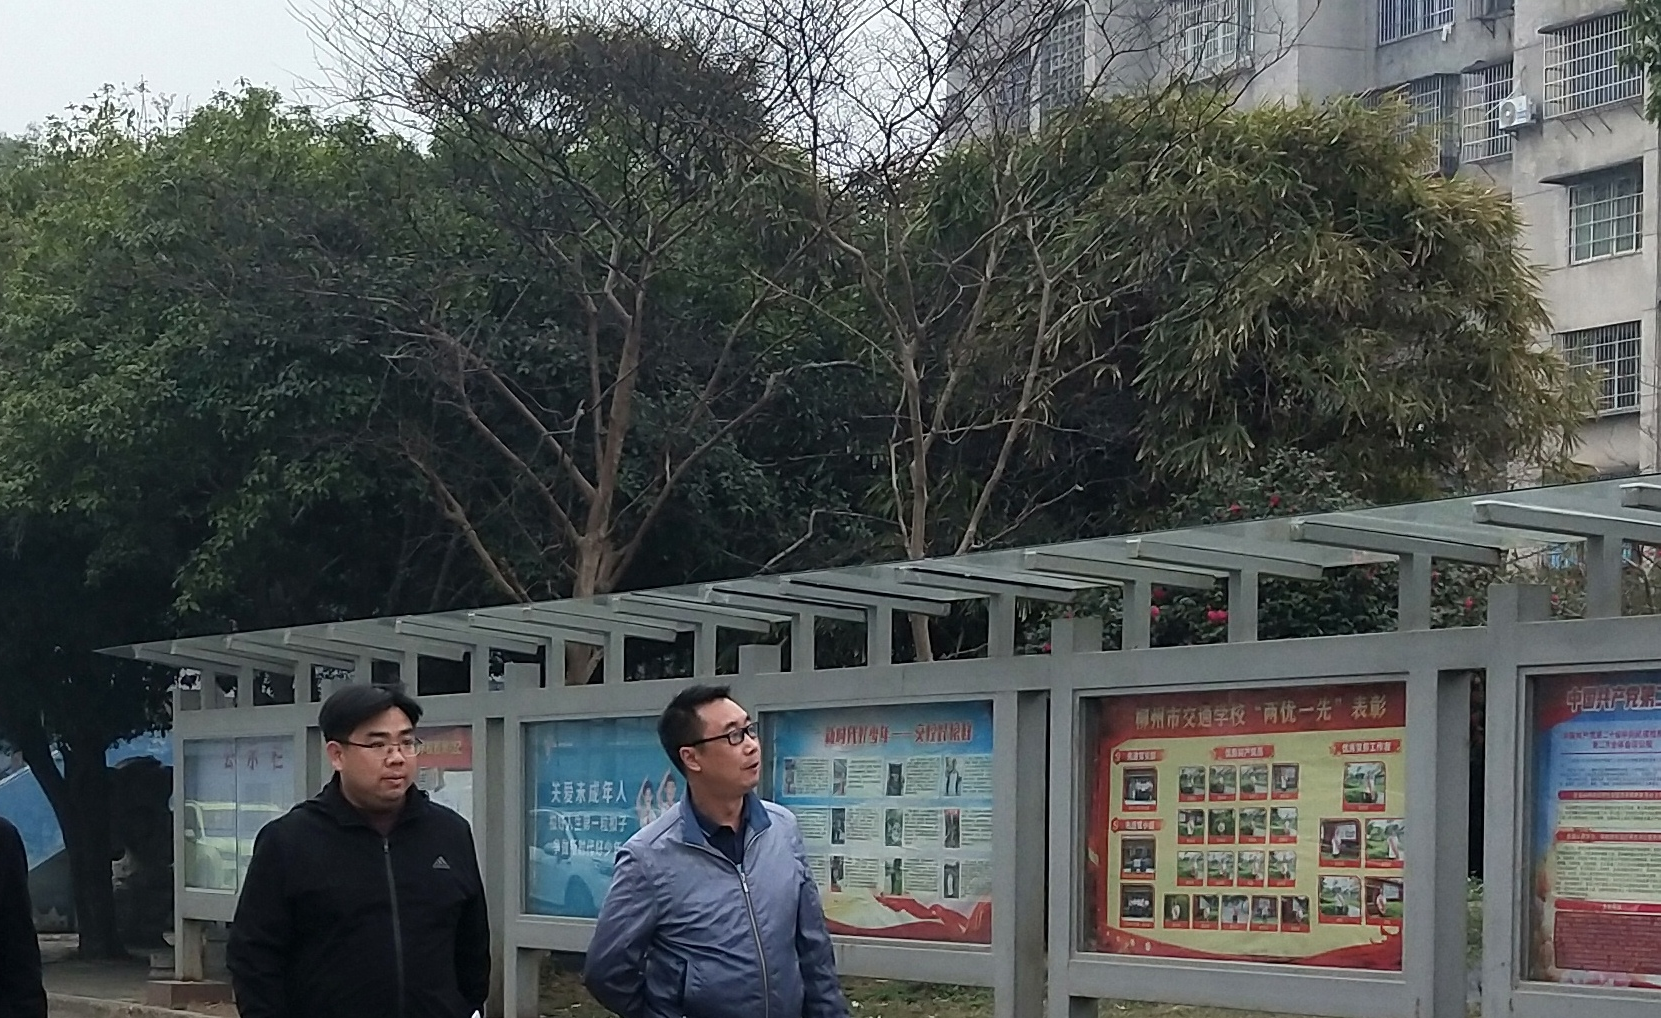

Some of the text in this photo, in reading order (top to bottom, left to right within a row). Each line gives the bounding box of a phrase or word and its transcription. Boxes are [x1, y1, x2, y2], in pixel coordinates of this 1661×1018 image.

[1135, 703, 1247, 730] 柳州市交通学校
[1351, 694, 1387, 720] 表彰
[550, 780, 628, 804] 关爱未成年人
